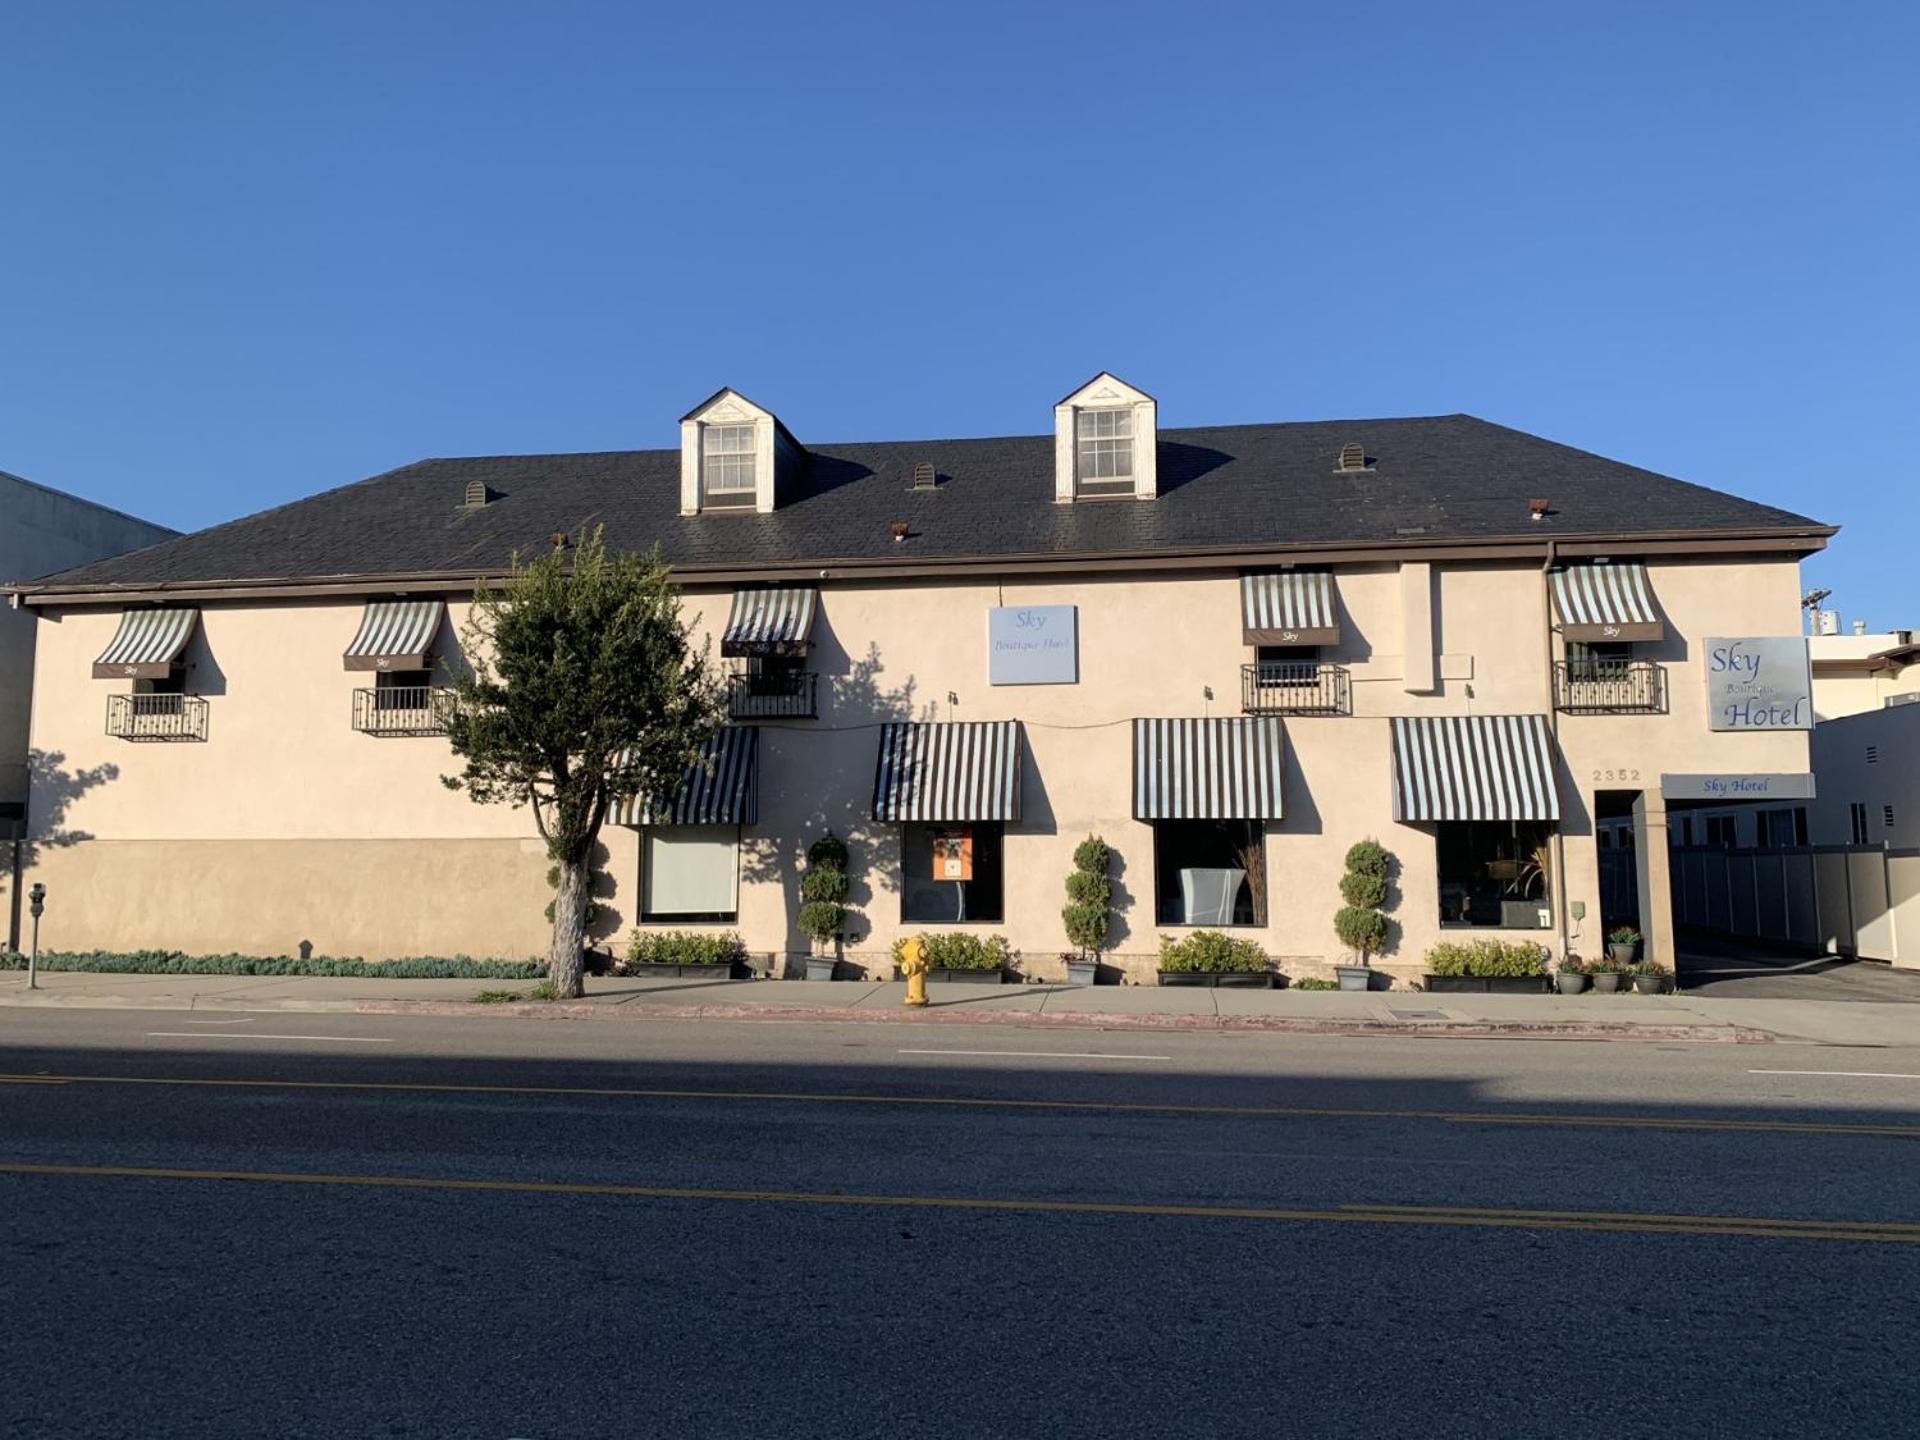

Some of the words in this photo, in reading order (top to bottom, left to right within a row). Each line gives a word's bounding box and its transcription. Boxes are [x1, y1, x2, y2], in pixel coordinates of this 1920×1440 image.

[1016, 610, 1047, 631] Sky
[1282, 631, 1299, 642] Sky
[1603, 626, 1620, 637] Sky
[376, 658, 390, 668] Sky
[1711, 641, 1760, 684] Sky
[124, 666, 138, 676] Sky
[1724, 697, 1807, 725] Hotel
[1592, 769, 1641, 781] 2352
[1704, 779, 1728, 797] Sky
[1732, 778, 1770, 792] Hotel
